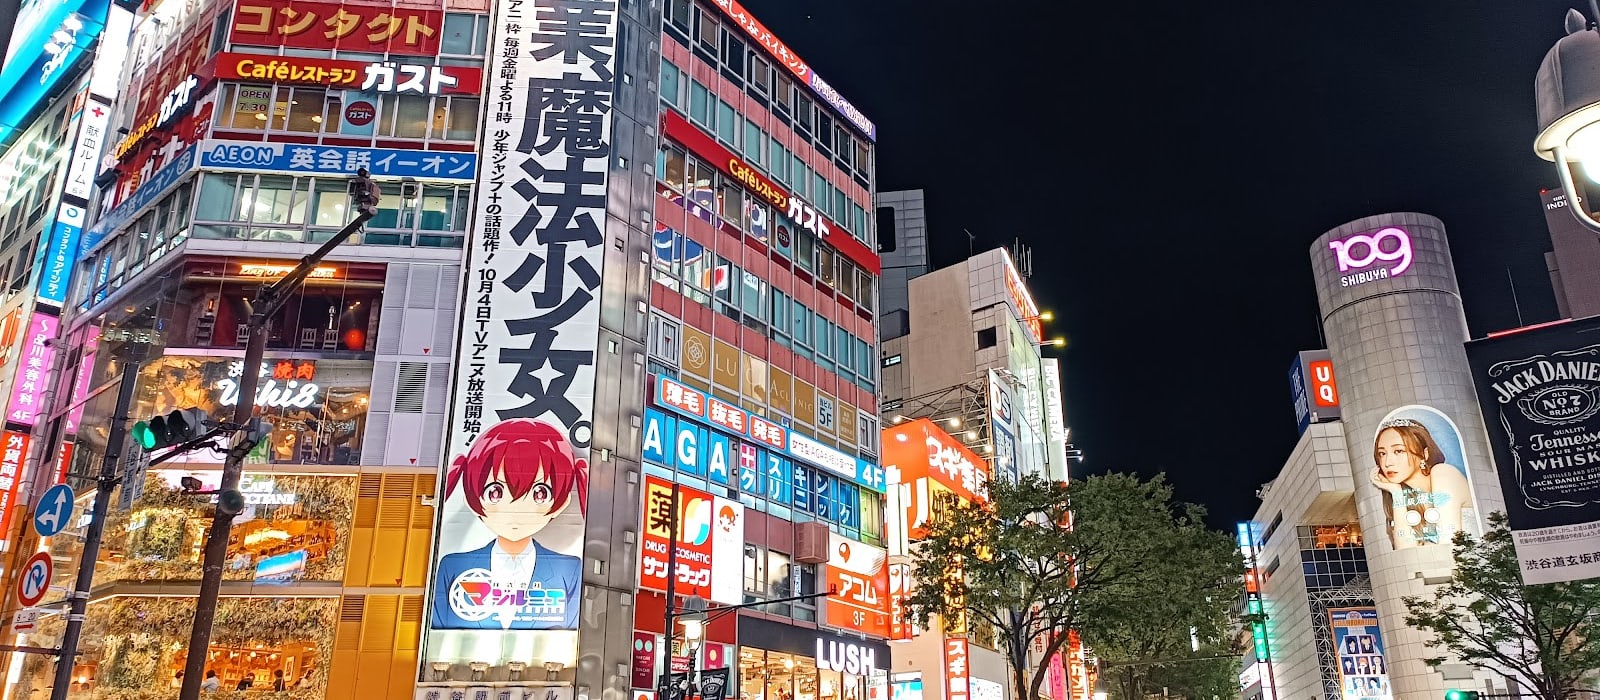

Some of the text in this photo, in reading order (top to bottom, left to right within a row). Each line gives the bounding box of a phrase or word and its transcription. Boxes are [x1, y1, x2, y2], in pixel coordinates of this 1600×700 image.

[235, 5, 435, 45] コンタクト
[362, 62, 458, 94] ガスト
[496, 37, 520, 123] 毎週金曜よる11時
[157, 75, 198, 128] ガスト
[241, 90, 270, 99] OPEN
[74, 124, 99, 185] 献血ルーム
[211, 146, 275, 164] AEON
[289, 147, 471, 175] 英会話イーオン
[788, 196, 829, 239] ガスト
[1328, 226, 1414, 276] 109
[1341, 268, 1388, 287] SHIBUYA
[18, 333, 47, 406] 品川美容外科
[1315, 366, 1335, 403] UQ
[217, 378, 319, 408] Uhi8
[1491, 368, 1542, 404] JACK
[12, 409, 31, 421] 4F
[711, 399, 742, 431] 抜毛
[754, 418, 782, 447] 発毛
[819, 407, 832, 427] 5F
[1549, 406, 1580, 416] BRAND
[1553, 426, 1586, 436] QUALITY
[643, 418, 727, 478] AGA
[1540, 448, 1571, 457] SOUR
[862, 464, 883, 489] 4F
[1531, 479, 1553, 487] JACK
[1555, 475, 1586, 484] DANIEL
[651, 490, 671, 534] 薬
[645, 540, 711, 565] DRUG COSMETIC
[838, 573, 877, 605] アコム
[852, 610, 866, 627] 3F
[816, 637, 875, 677] LUSH
